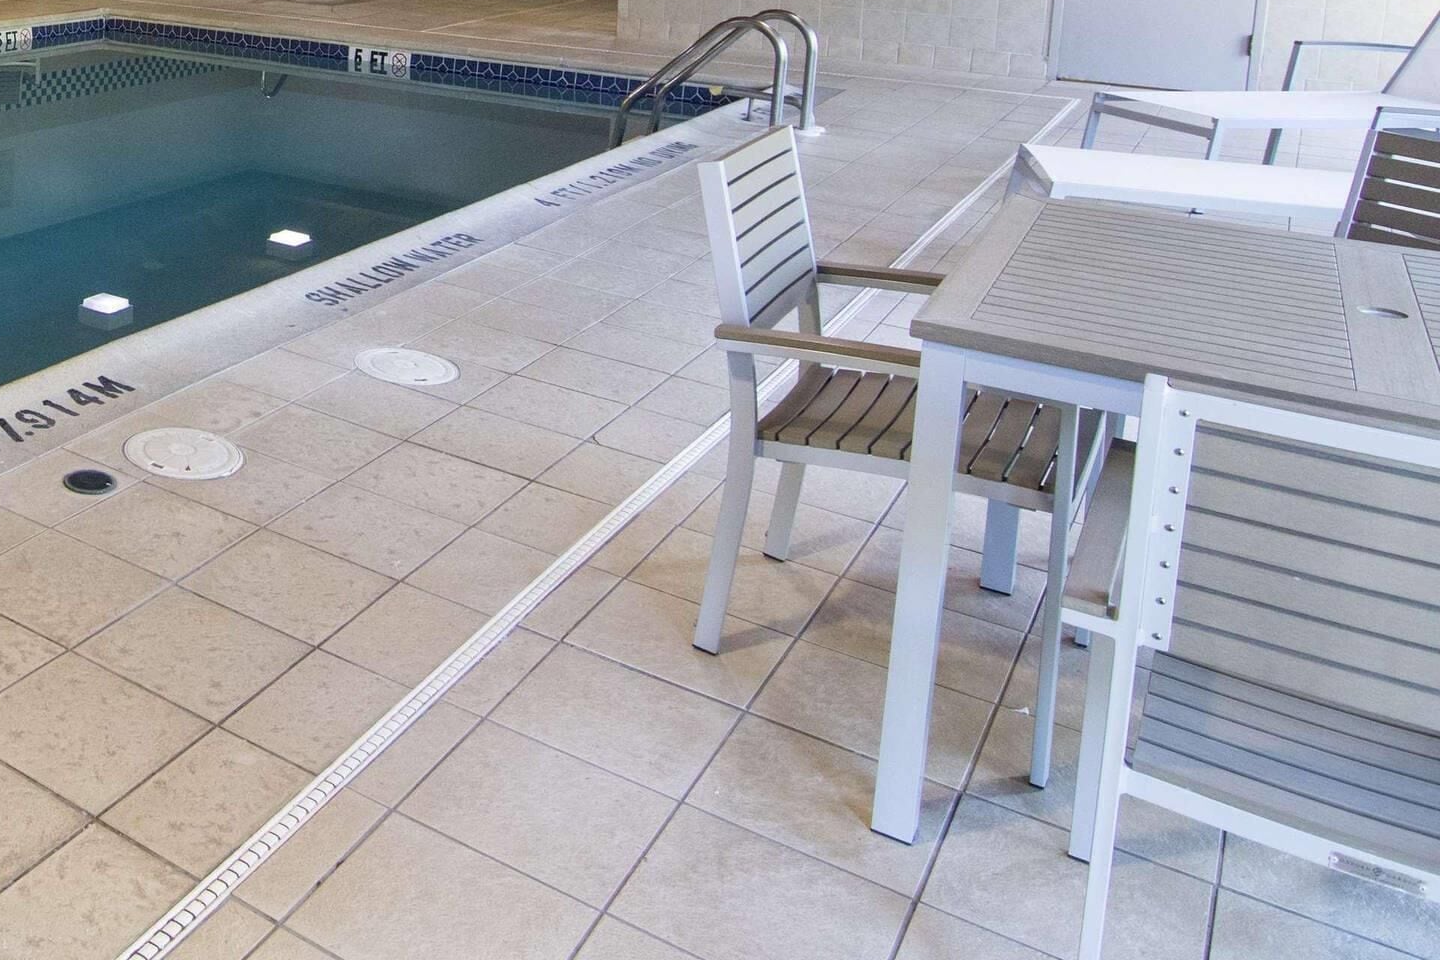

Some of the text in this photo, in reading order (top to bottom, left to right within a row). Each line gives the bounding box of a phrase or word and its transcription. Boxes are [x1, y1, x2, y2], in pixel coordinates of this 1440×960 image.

[534, 196, 561, 207] 4
[305, 233, 485, 306] SHALLOW WATER
